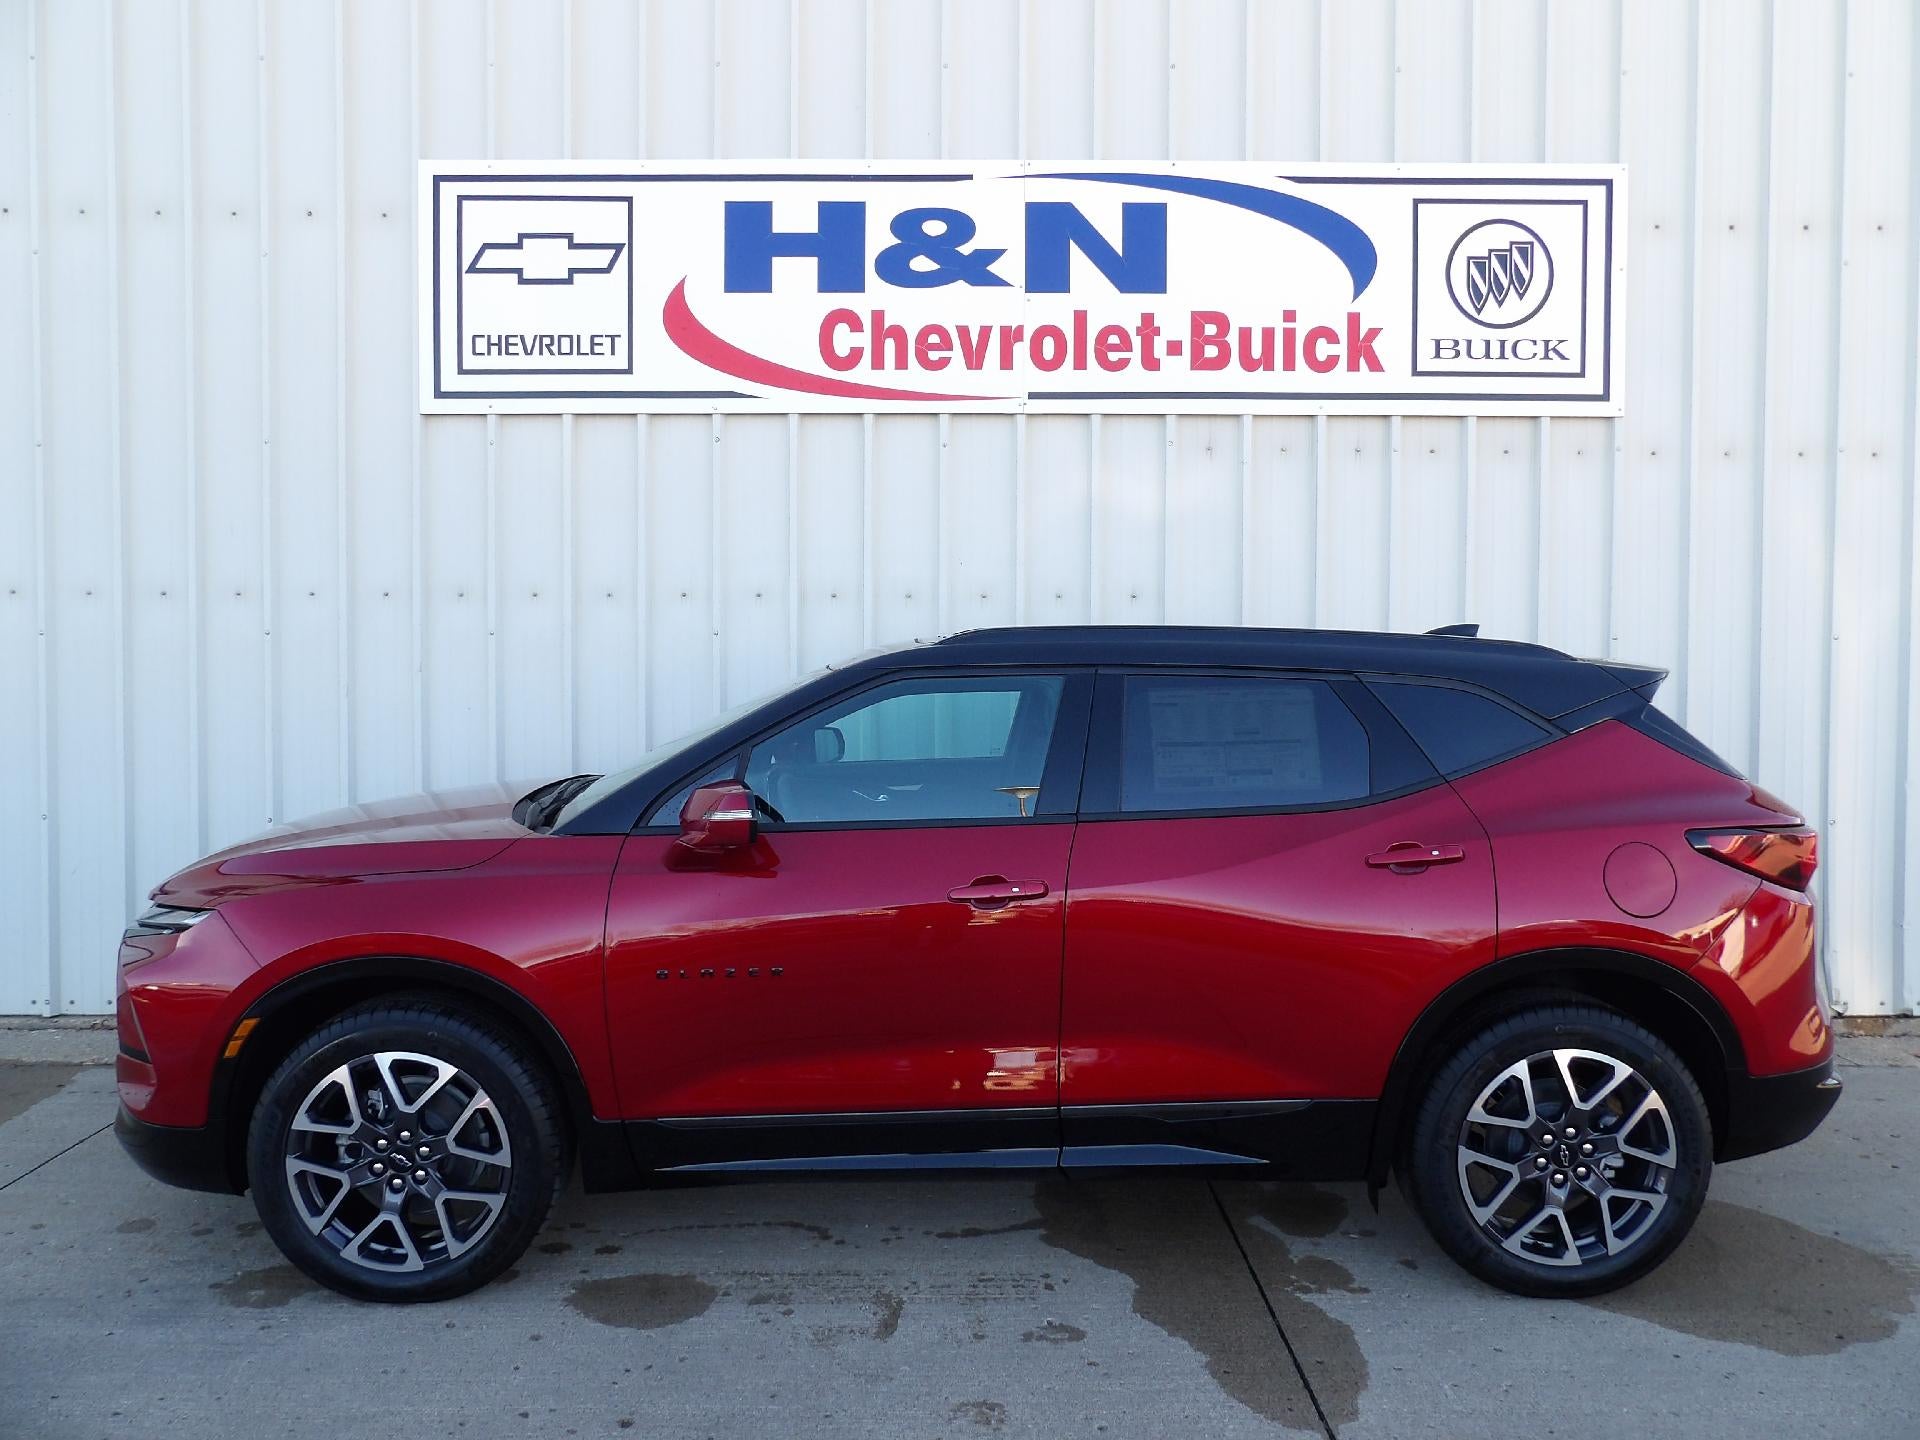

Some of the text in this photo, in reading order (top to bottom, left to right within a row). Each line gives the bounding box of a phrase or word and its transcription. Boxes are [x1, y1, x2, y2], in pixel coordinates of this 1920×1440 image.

[724, 201, 1167, 294] H&N
[471, 334, 621, 357] CHEVROLET
[819, 308, 1385, 372] Chevrolet-Buick
[1430, 338, 1570, 361] BUICK
[656, 966, 784, 979] BLAZER
